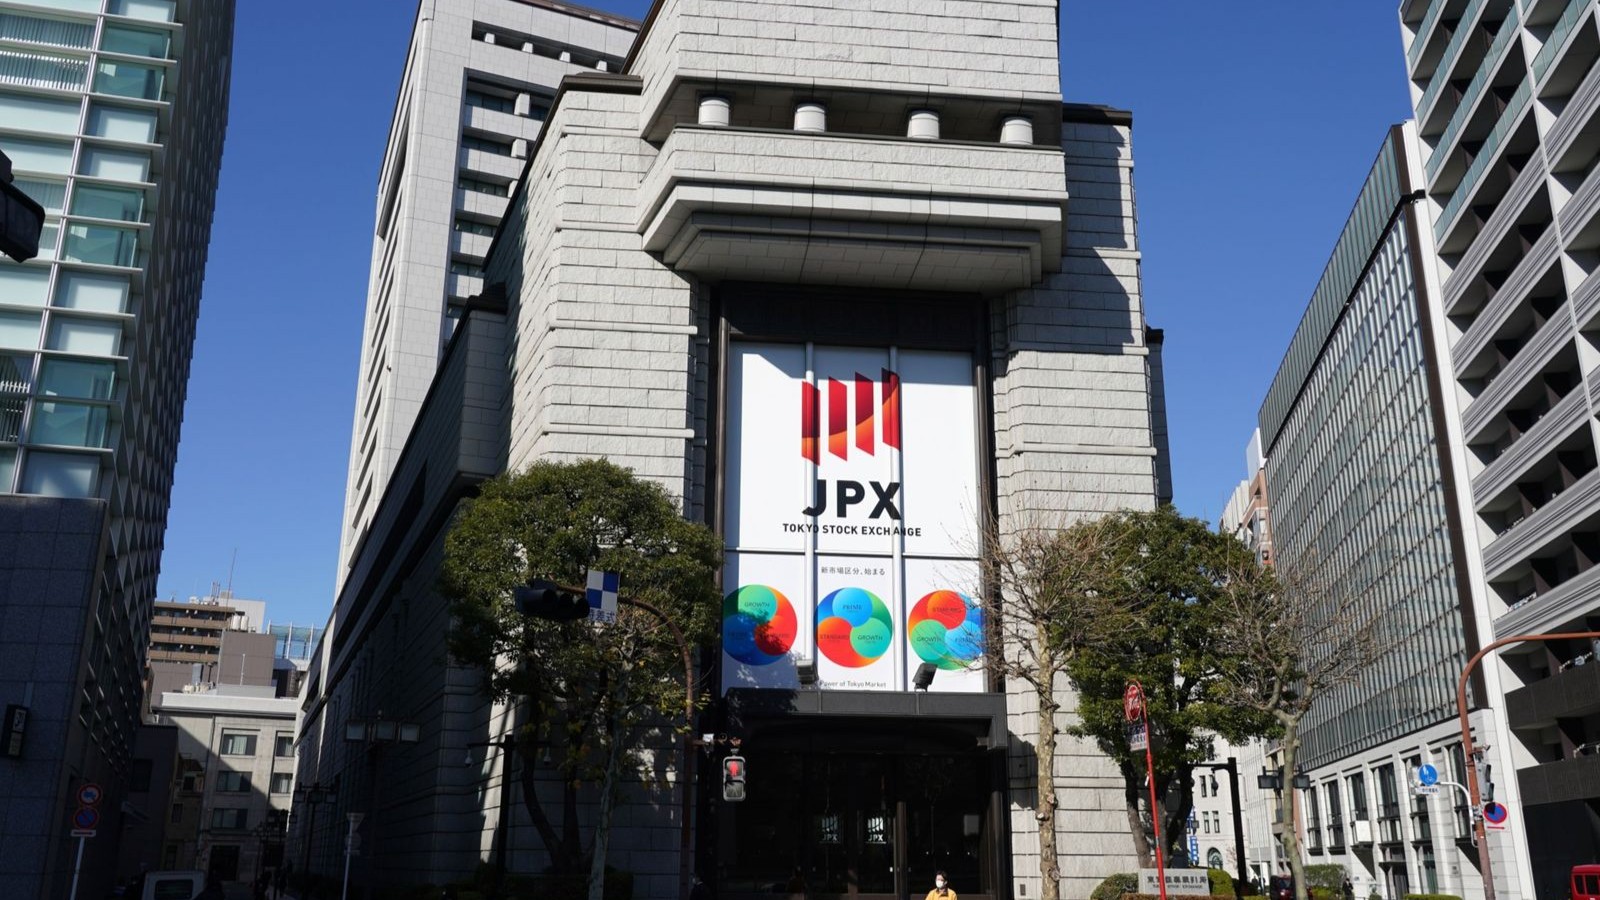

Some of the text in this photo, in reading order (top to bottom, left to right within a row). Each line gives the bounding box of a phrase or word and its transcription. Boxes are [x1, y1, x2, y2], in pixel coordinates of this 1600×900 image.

[802, 479, 902, 520] JPX
[783, 523, 922, 537] TOKYO STOCK EXCHANGE
[847, 681, 865, 689] Tokyo
